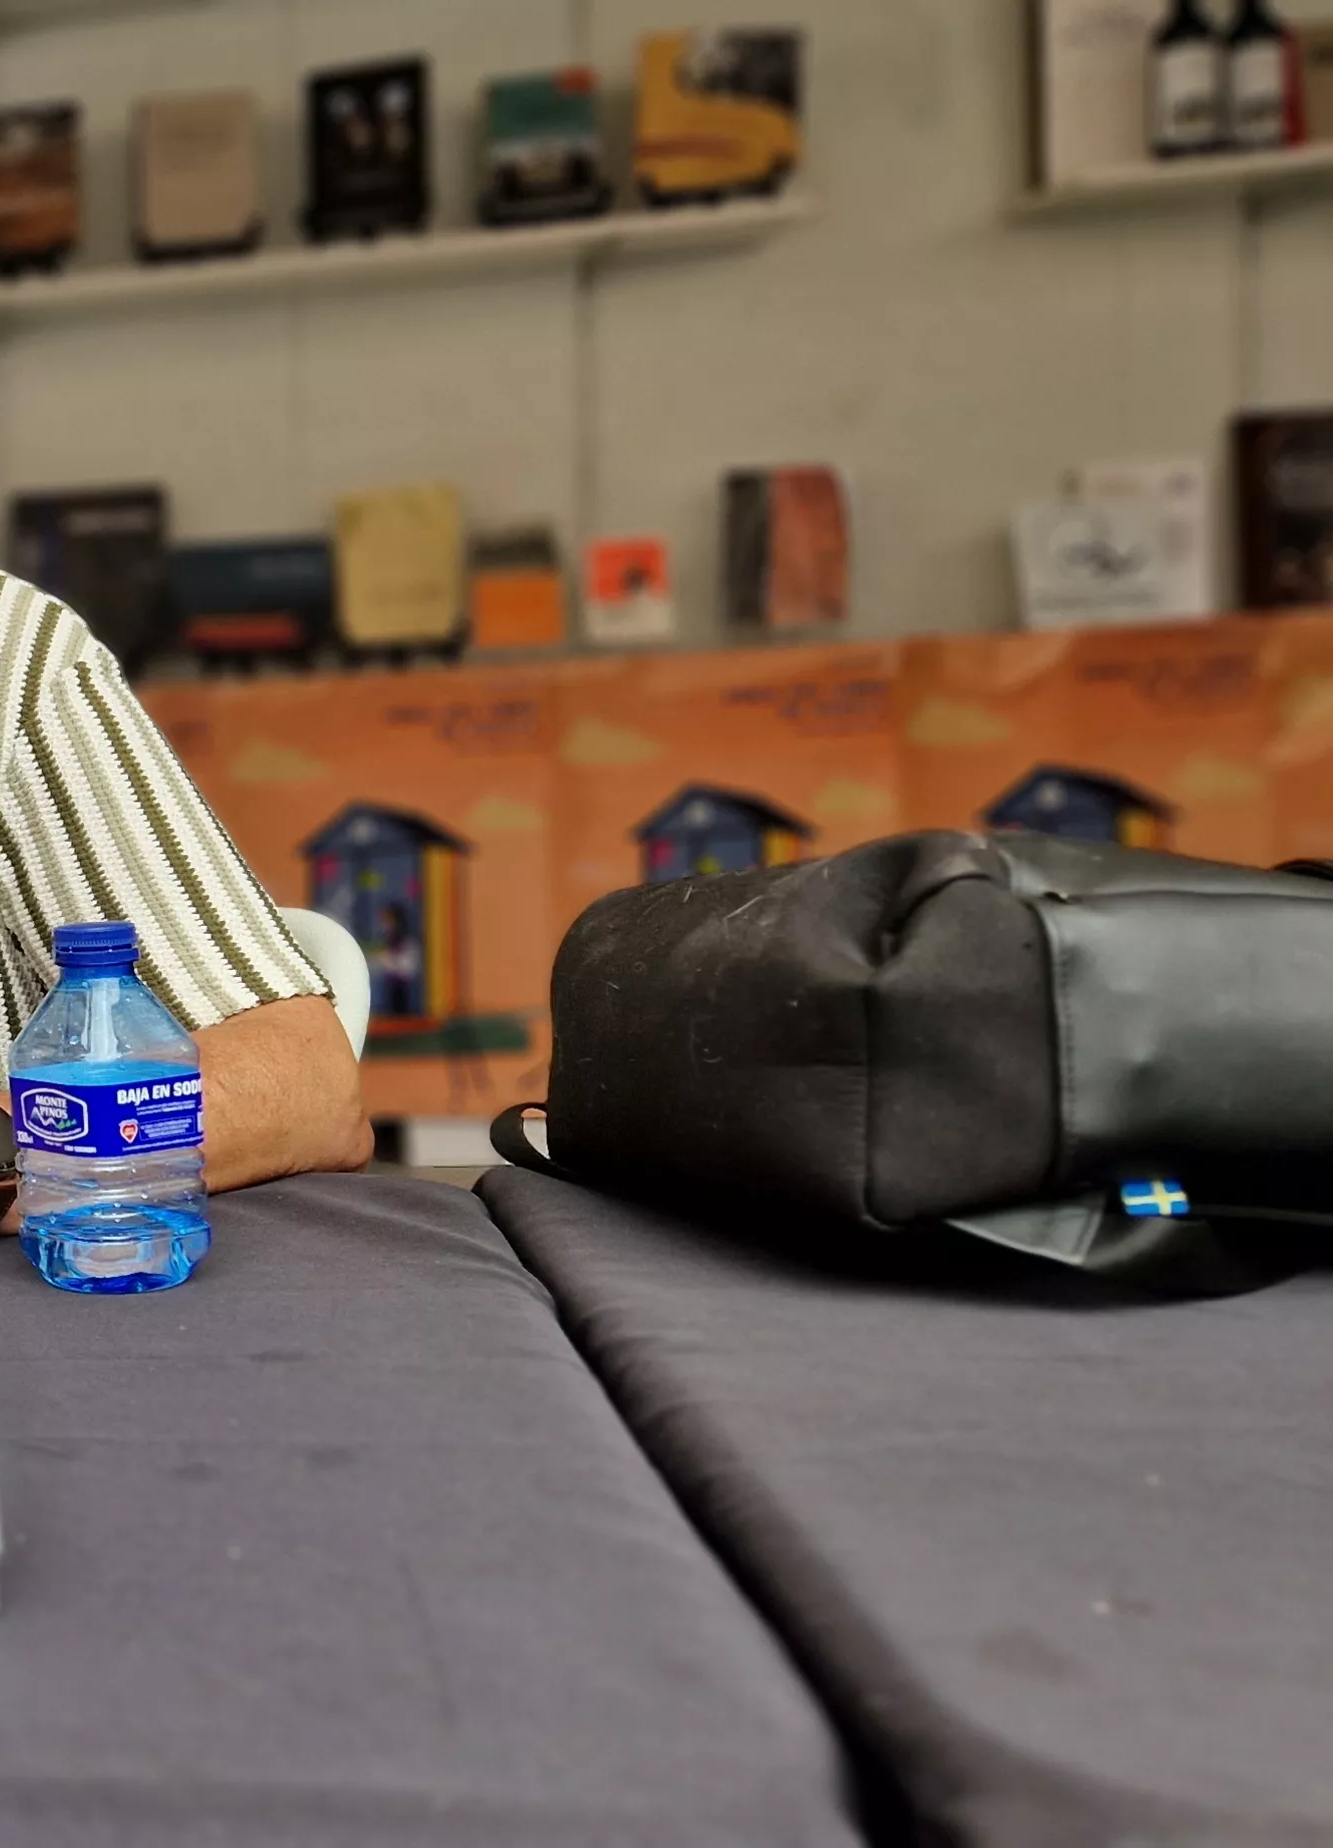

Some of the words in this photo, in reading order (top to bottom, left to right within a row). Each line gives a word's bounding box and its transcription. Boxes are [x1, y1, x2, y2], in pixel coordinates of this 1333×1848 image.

[35, 1094, 68, 1109] MONTE
[116, 1086, 150, 1107] BAJA
[152, 1083, 171, 1100] EN
[39, 1105, 69, 1119] PINOS
